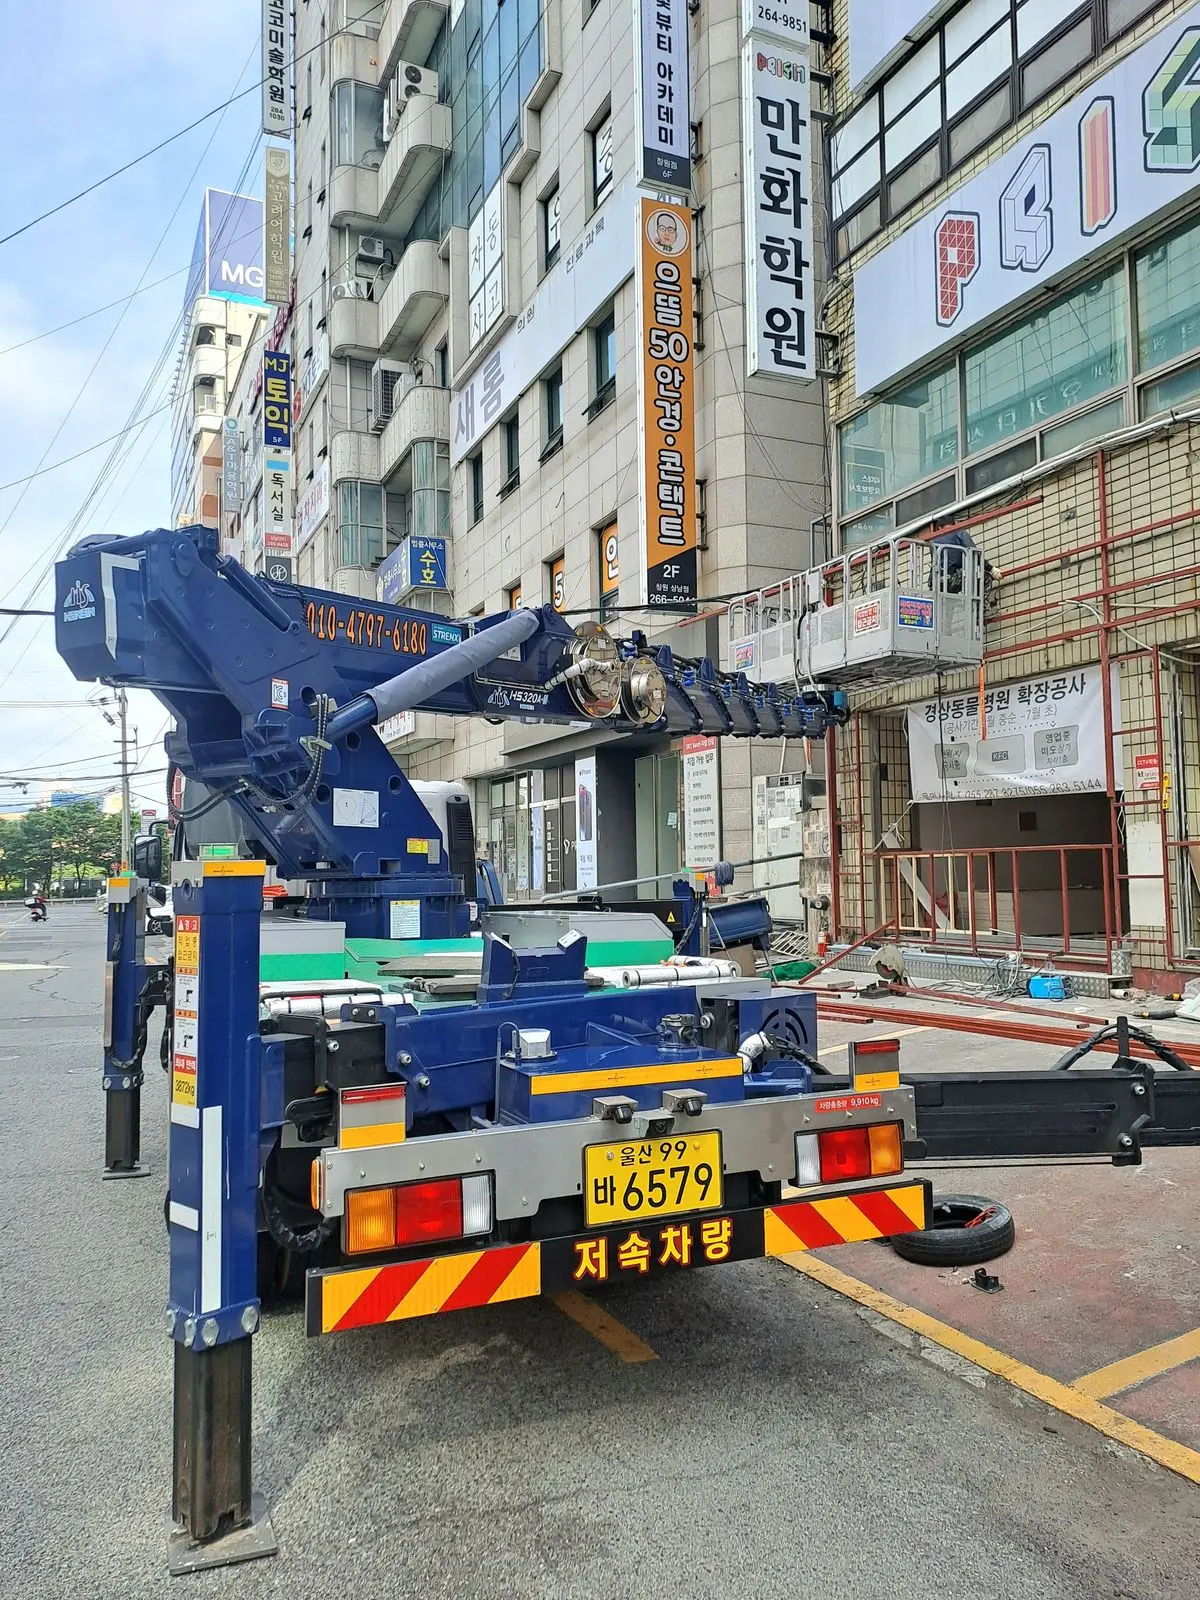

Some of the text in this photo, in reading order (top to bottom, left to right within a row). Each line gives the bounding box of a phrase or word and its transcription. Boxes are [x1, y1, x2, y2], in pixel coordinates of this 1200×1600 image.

[757, 5, 807, 34] 264-9851
[656, 61, 674, 146] 아카데미
[656, 157, 679, 170] 창원점
[662, 170, 673, 179] 6F
[565, 216, 606, 275] 진료과목
[756, 95, 811, 370] 만화학원
[220, 259, 264, 288] MG
[516, 303, 536, 335] 의원
[265, 356, 289, 373] MJ
[264, 377, 290, 435] 토익
[454, 349, 505, 445] 새롬
[270, 472, 285, 522] 독서실
[419, 549, 437, 585] 수호
[662, 564, 681, 579] 2F
[306, 601, 427, 656] 010-4797-6180
[925, 672, 1087, 723] 경상동물병원 확장공사
[1045, 730, 1070, 743] 영업중
[620, 1140, 687, 1168] 울산 99
[593, 1162, 713, 1212] 바 6579
